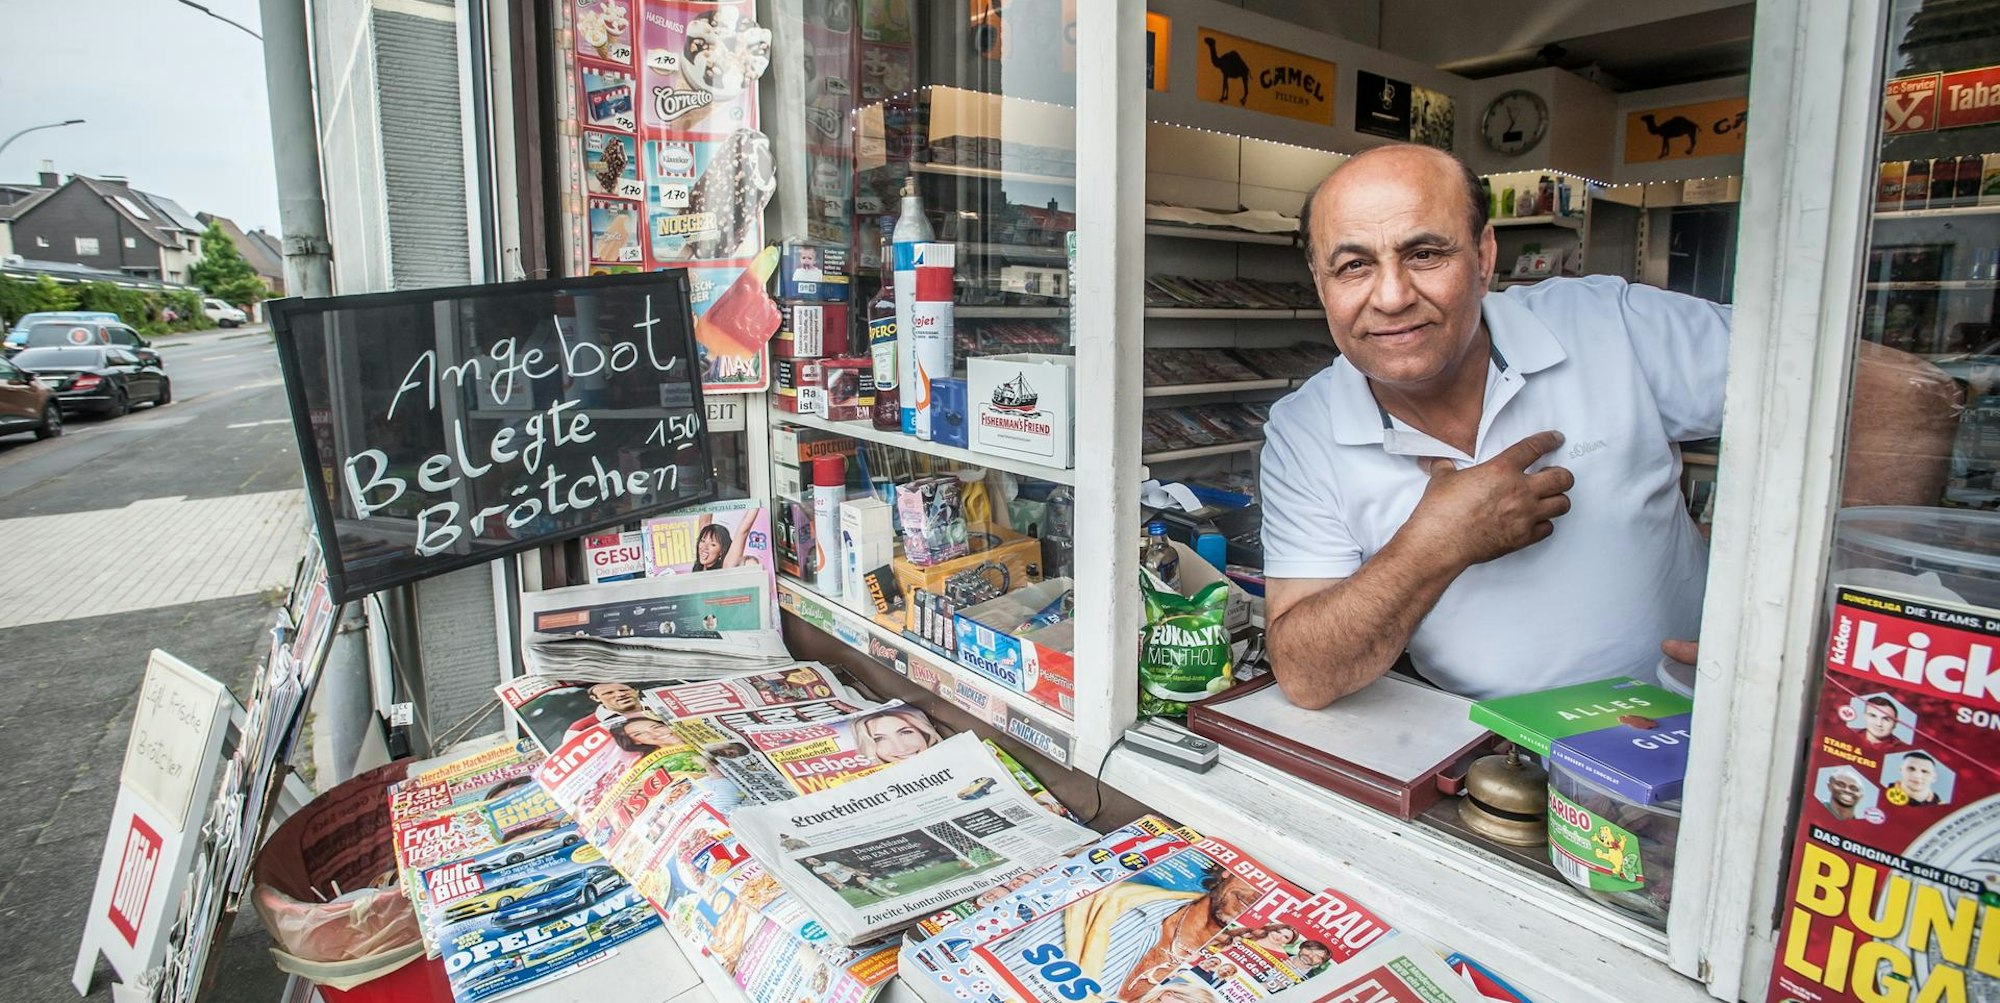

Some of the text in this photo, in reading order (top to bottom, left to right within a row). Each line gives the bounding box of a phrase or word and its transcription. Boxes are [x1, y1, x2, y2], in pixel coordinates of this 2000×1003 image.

[645, 11, 685, 35] HASELNUSS
[1259, 66, 1325, 102] CAMEL
[1886, 79, 1937, 94] ac-Service
[653, 85, 714, 123] Cornetto
[657, 213, 718, 237] NOGGER
[387, 295, 677, 421] Angebot
[720, 356, 755, 378] MAX
[645, 416, 697, 450] 1.50
[981, 412, 1051, 436] FISHERMAN'S FRIEND
[344, 399, 597, 520] Belegte
[415, 455, 678, 557] Brötchen
[594, 546, 641, 566] GESU
[596, 568, 610, 577] Die
[611, 565, 636, 576] große
[1842, 592, 1902, 613] BUNDESLIGA
[1904, 605, 1927, 618] DIE
[1930, 609, 1982, 628] TEAMS.
[870, 637, 898, 661] Mars
[1829, 615, 1852, 665] kicker
[963, 648, 1017, 685] mentos
[1148, 648, 1217, 667] MENTHOL
[955, 681, 987, 708] SNICKERS
[1557, 697, 1651, 721] ALLES
[781, 746, 802, 757] Tage
[803, 740, 828, 751] voller
[1010, 719, 1052, 752] SNICKERS
[1631, 729, 1691, 751] GUT
[1823, 736, 1853, 752] STARS
[541, 732, 606, 783] tina
[785, 753, 871, 777] Liebes
[1823, 745, 1877, 768] TRANSFERS
[420, 760, 461, 782] Herzhafte
[470, 767, 508, 783] NEUE
[888, 767, 955, 800] Anzeiger
[393, 783, 447, 803] Frau
[394, 796, 450, 820] Heute
[596, 767, 674, 850] Lisa
[404, 821, 452, 848] Frau
[1142, 819, 1160, 835] Mit
[1178, 828, 1196, 841] Mit
[852, 836, 909, 855] Deutschland
[1196, 838, 1240, 864] DER
[1813, 828, 1980, 893] DAS ORIGINAL seit 1963
[433, 874, 481, 903] Bild
[863, 906, 904, 926] Zweite
[905, 885, 975, 912] Kontrollfirma
[975, 877, 989, 889] für
[990, 865, 1026, 884] Airport
[1301, 890, 1383, 949] FRAU
[446, 926, 552, 976] OPEL
[1304, 918, 1353, 957] SPIEGEL
[1228, 950, 1248, 963] mit
[1245, 962, 1267, 983] dem
[1784, 906, 1967, 1003] LIGA
[1022, 942, 1102, 1002] SOS
